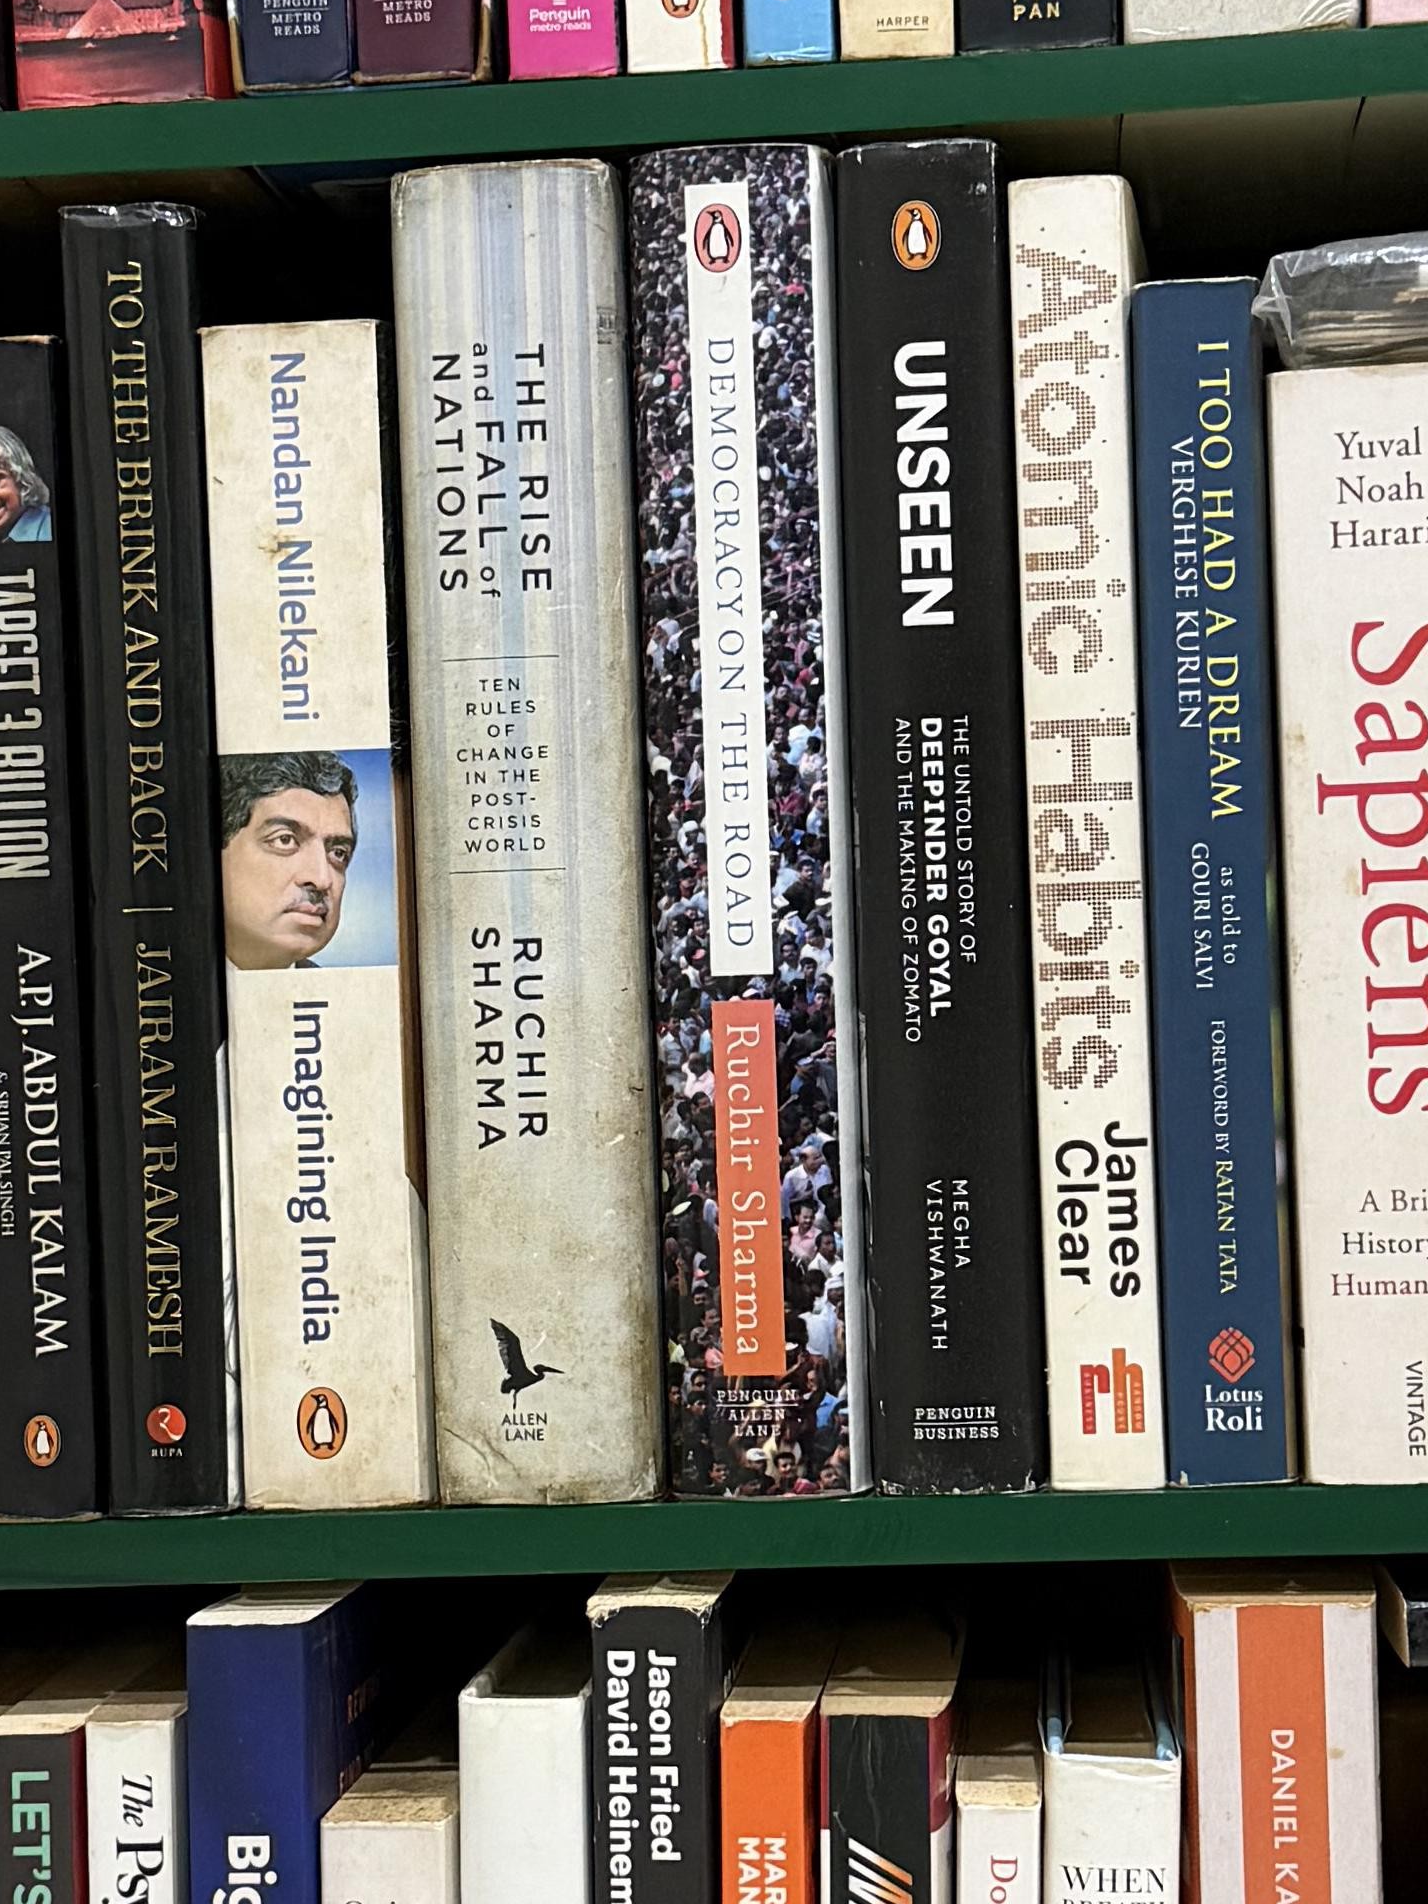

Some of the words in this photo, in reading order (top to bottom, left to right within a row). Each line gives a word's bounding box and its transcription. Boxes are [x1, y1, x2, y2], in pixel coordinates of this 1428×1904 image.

[271, 11, 323, 25] METRO
[273, 23, 322, 37] READS
[876, 14, 929, 27] HARPER
[1013, 4, 1061, 20] PAN
[1017, 239, 1126, 679] Atomic
[1335, 429, 1422, 465] Yuval
[892, 340, 955, 629] UNSEEN
[1336, 473, 1426, 506] Noah
[1027, 715, 1139, 1095] Habits
[0, 1181, 16, 1237] SINGH
[1404, 1359, 1427, 1457] VINTAGE
[117, 1773, 153, 1827] The
[1061, 1865, 1167, 1895] WHEN
